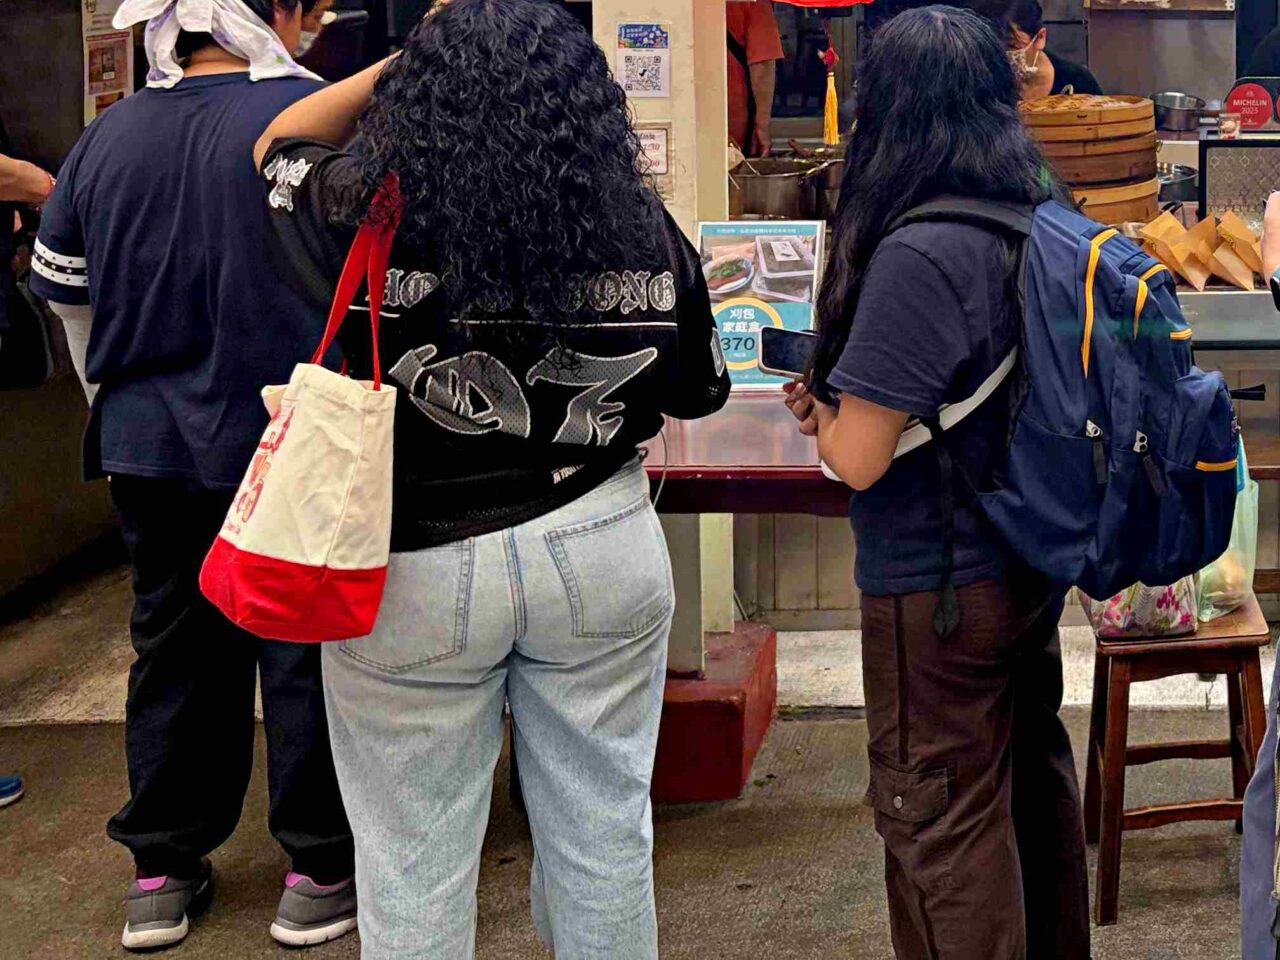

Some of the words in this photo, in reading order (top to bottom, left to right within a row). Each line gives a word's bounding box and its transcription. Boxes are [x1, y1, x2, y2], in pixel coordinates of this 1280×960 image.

[1233, 99, 1267, 107] MICHELIN
[730, 308, 755, 319] 刈包
[720, 337, 756, 351] 370
